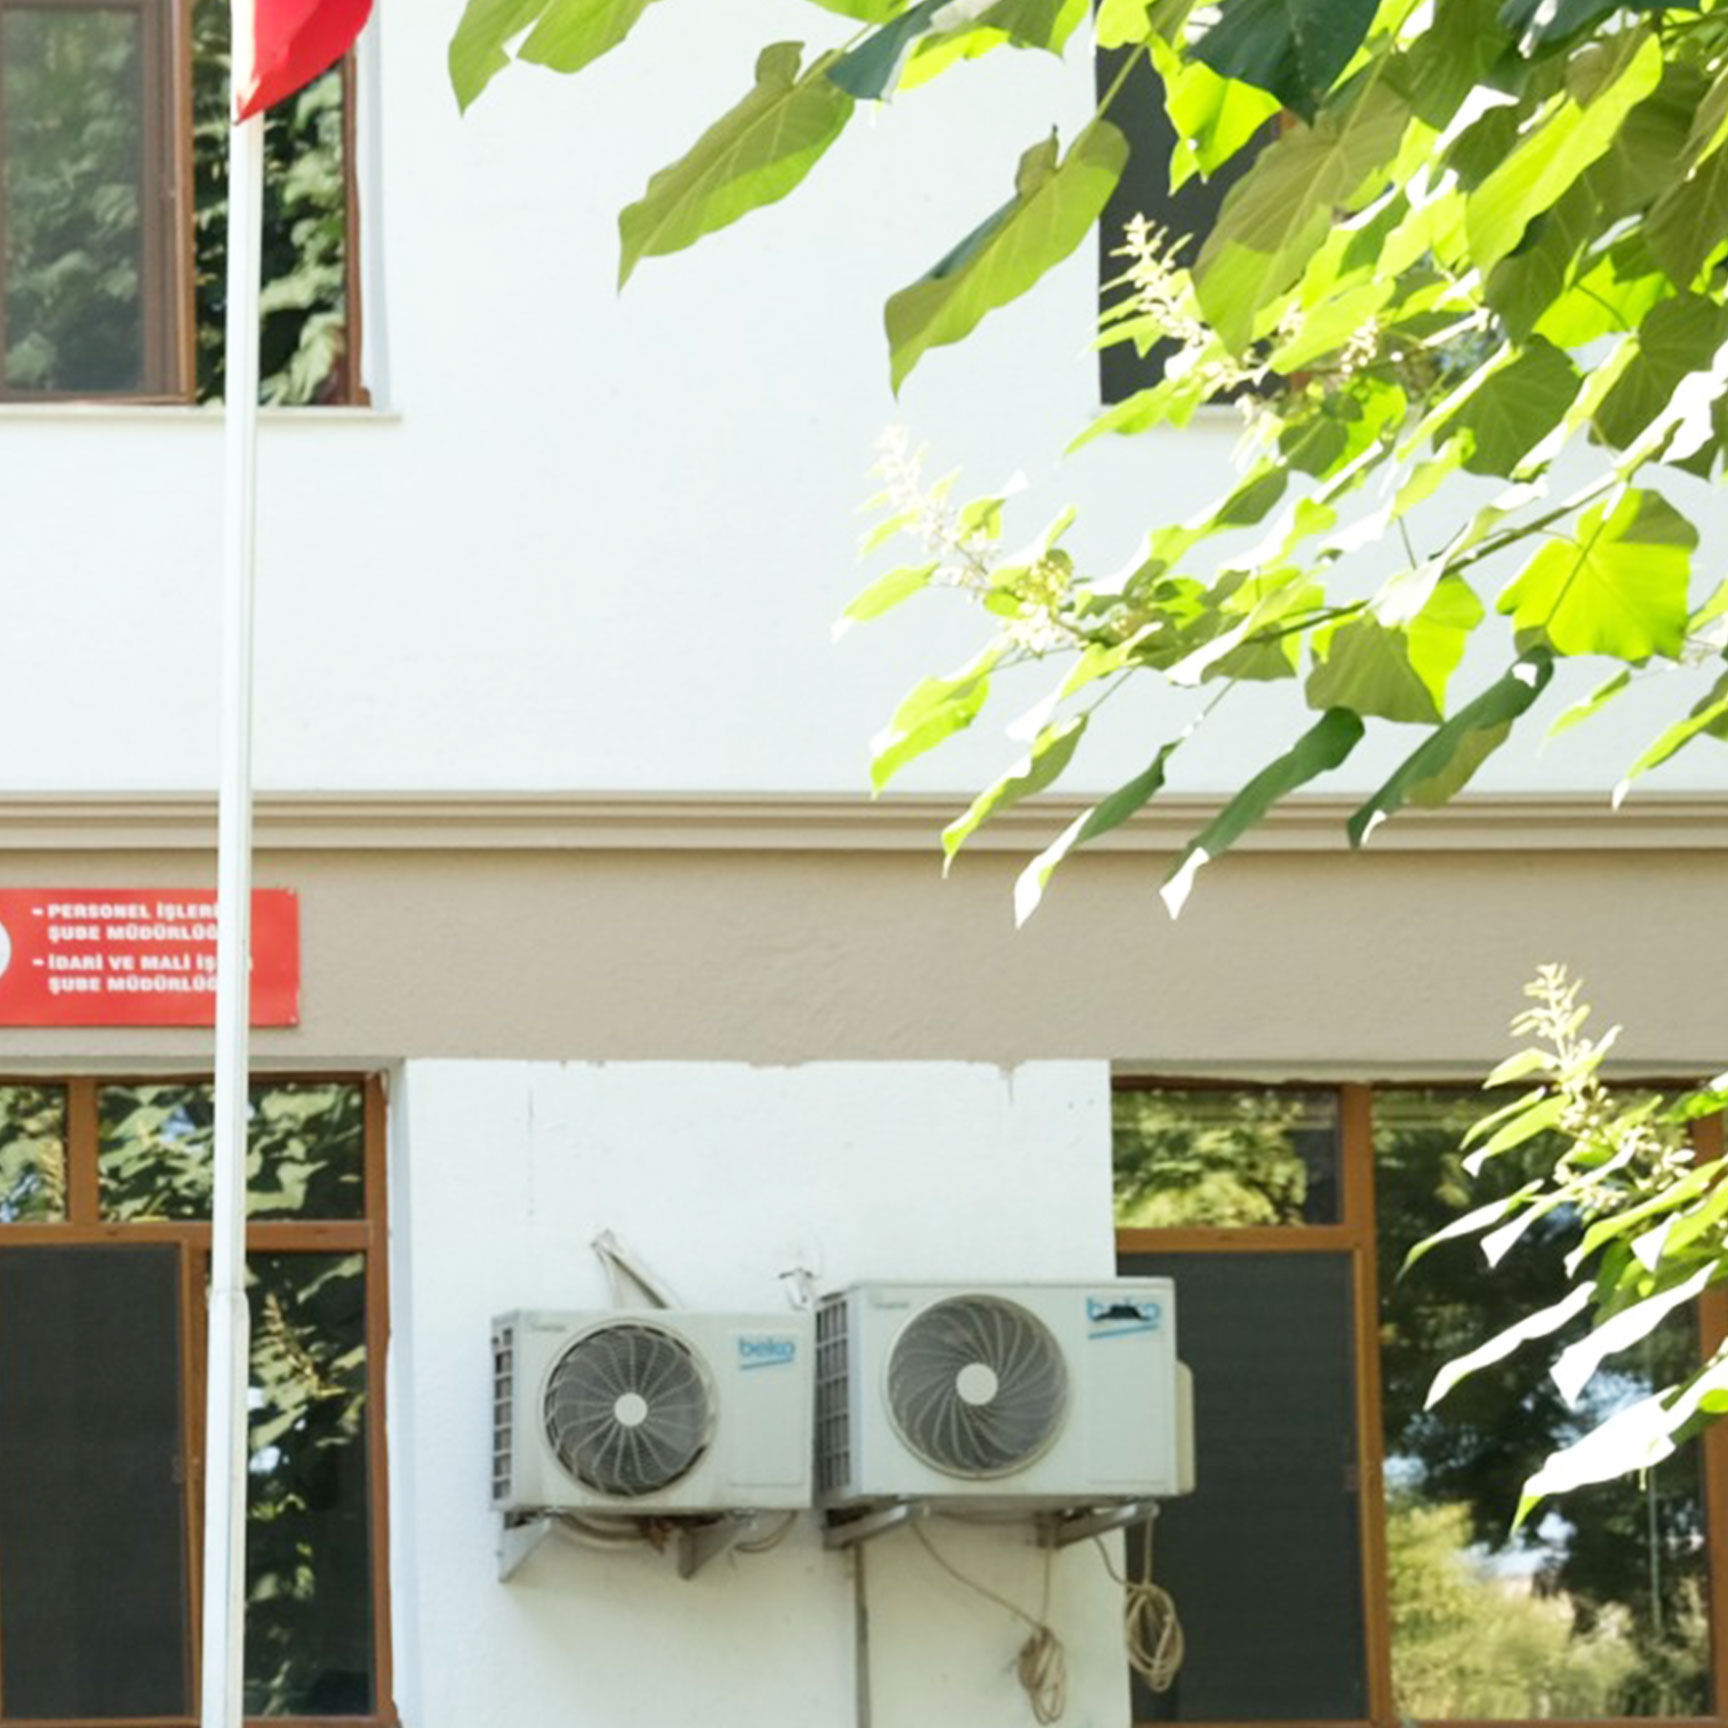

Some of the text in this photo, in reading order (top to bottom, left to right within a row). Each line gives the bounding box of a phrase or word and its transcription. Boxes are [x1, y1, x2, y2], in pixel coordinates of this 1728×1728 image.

[47, 903, 151, 919] PERSONEL
[47, 925, 100, 944] ŞUBE
[47, 953, 104, 971] İDARİ
[108, 955, 135, 971] VE
[140, 953, 191, 971] MALİ
[47, 976, 101, 995] ŞUBE
